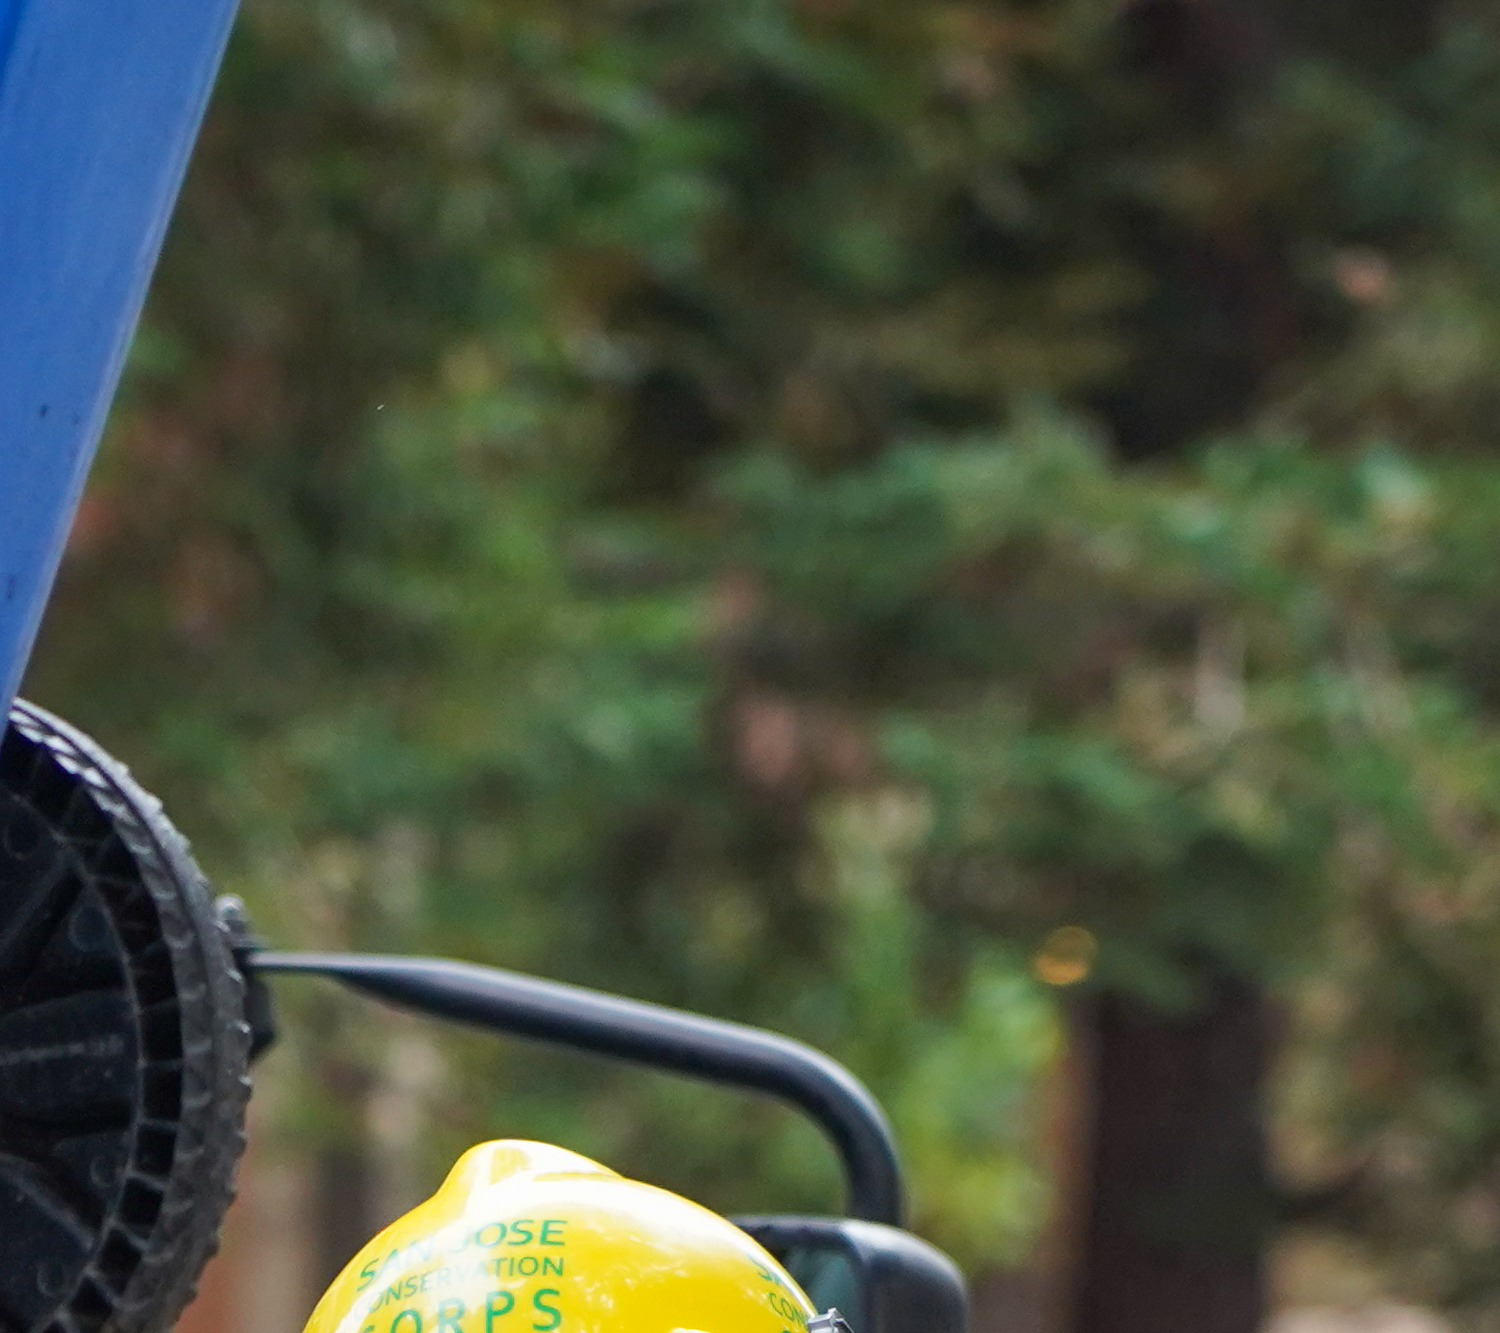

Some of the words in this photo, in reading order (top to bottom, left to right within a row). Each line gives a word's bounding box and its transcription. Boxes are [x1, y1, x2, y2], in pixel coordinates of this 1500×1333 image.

[354, 1256, 565, 1320] CONSERVATION
[356, 1235, 434, 1292] SAN
[452, 1219, 568, 1253] JOSE
